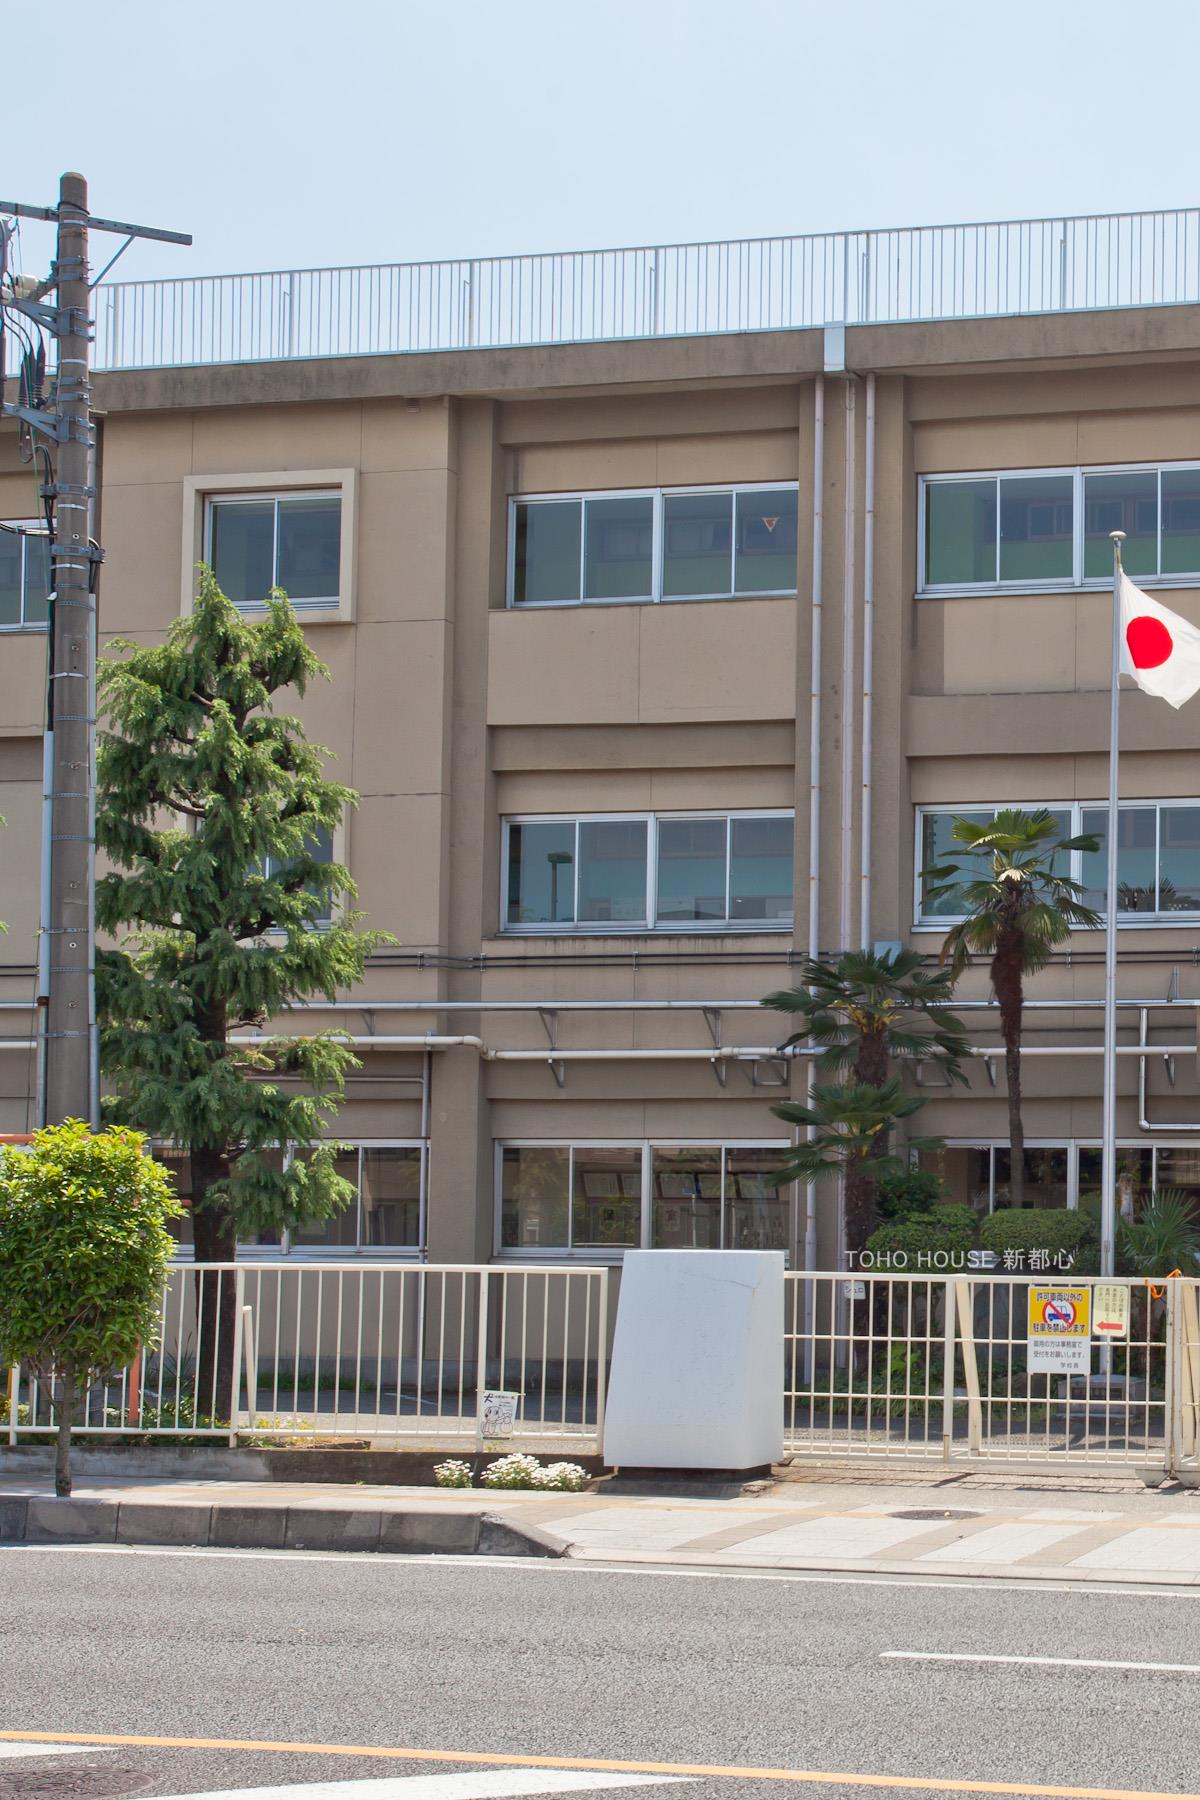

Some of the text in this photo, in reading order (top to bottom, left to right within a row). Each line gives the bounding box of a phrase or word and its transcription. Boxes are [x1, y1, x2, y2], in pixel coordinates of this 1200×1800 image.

[1036, 1292, 1083, 1301] 許可車両以外の
[1033, 1322, 1086, 1333] 駐車を禁止します
